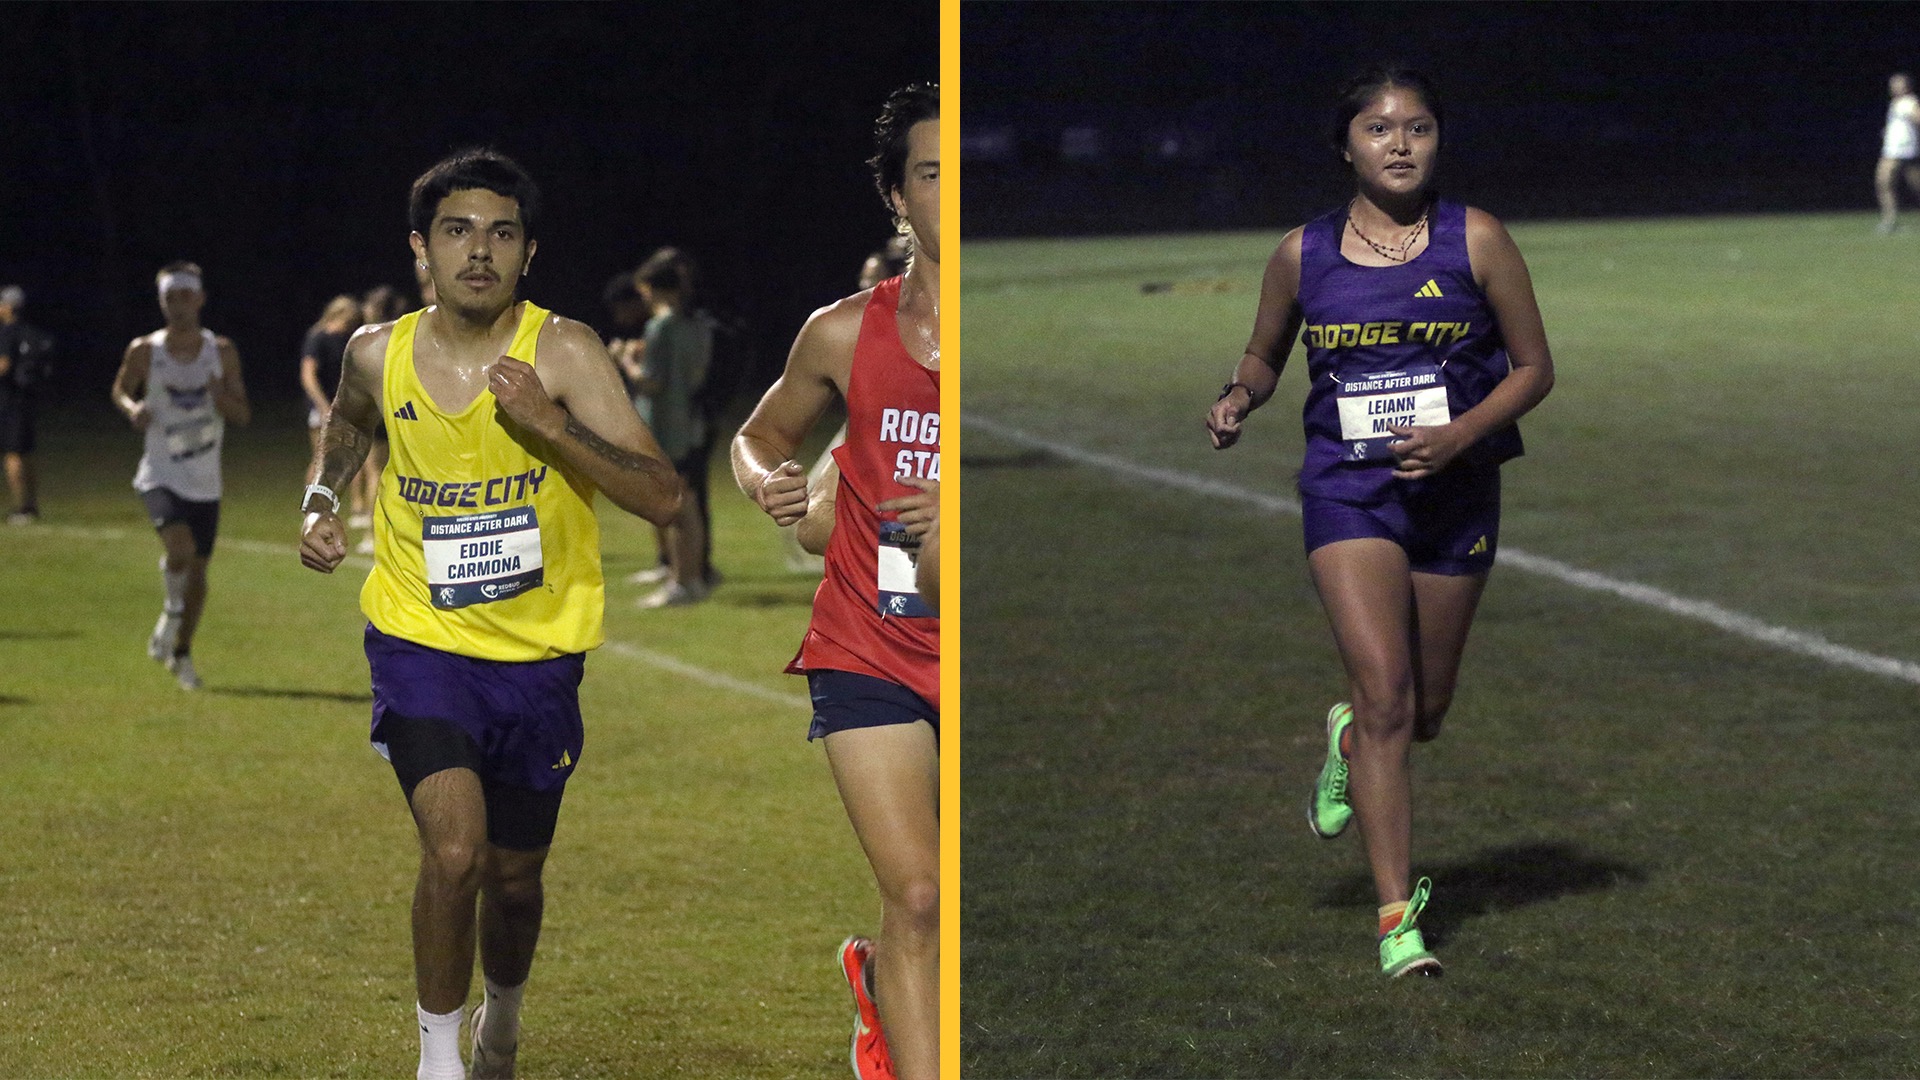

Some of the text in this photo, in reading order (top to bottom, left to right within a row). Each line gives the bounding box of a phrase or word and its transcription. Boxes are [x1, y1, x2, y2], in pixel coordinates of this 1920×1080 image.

[1309, 322, 1471, 349] DODGE CITY
[1345, 381, 1383, 392] DISTANCE
[1384, 377, 1411, 389] AFTER
[1413, 373, 1436, 386] DARK
[1368, 396, 1416, 415] LEIANN
[880, 408, 940, 446] ROG
[484, 465, 548, 506] CITY
[430, 522, 472, 535] DISTANCE
[473, 518, 502, 532] AFTER
[503, 514, 529, 528] DARK
[460, 539, 503, 559] EDDIE
[447, 555, 521, 580] CARMONA
